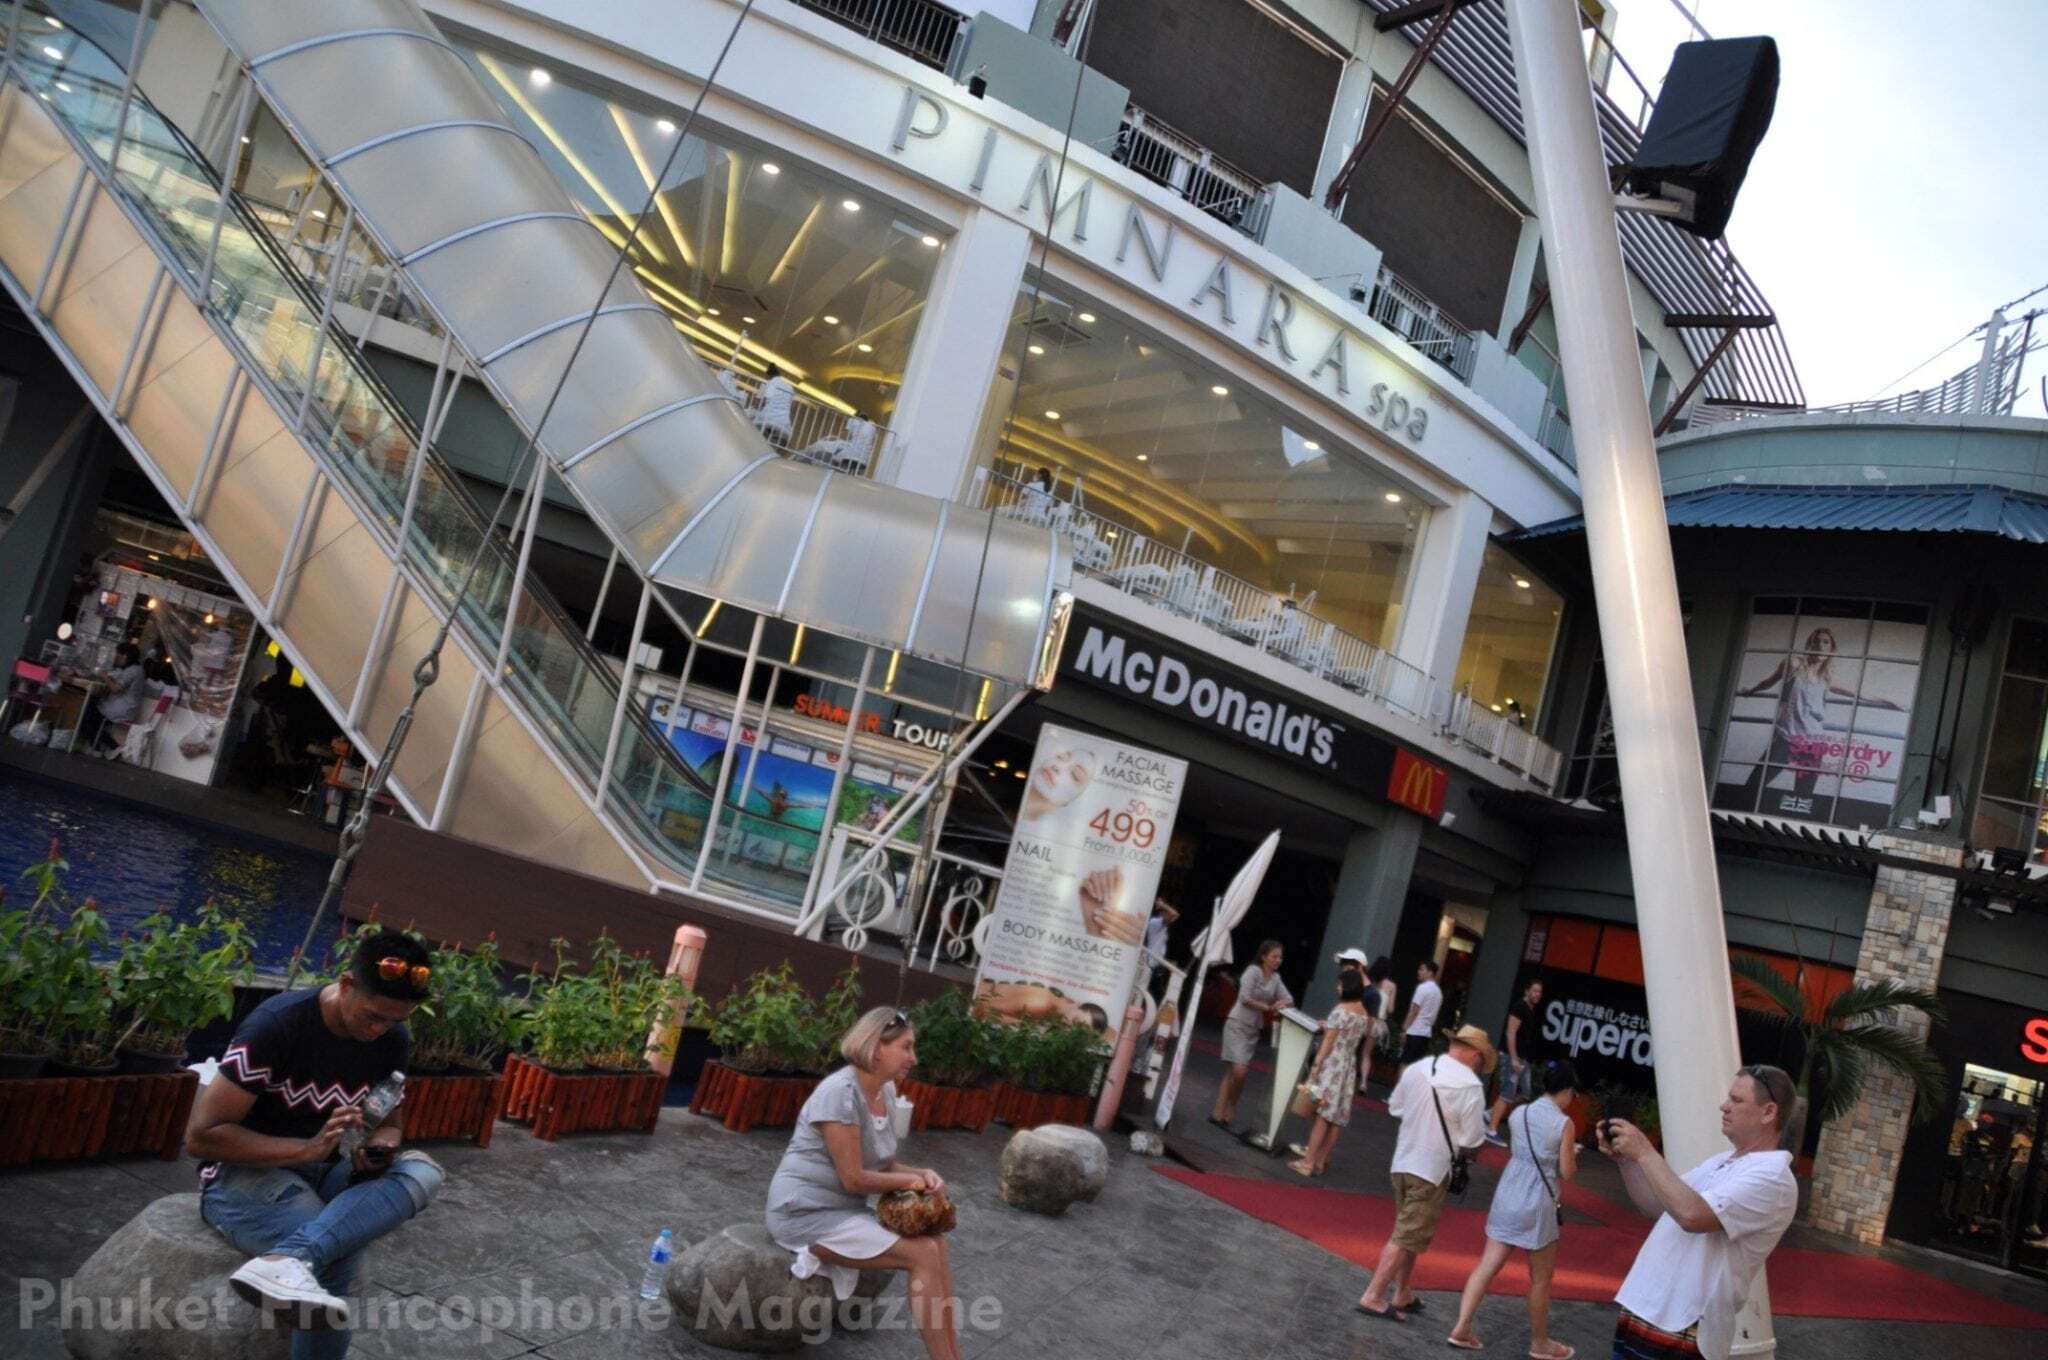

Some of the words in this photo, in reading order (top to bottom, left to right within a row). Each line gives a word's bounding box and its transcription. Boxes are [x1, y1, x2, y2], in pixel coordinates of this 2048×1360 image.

[890, 84, 1352, 396] PIMNARA
[1364, 380, 1430, 442] spa
[1074, 626, 1337, 768] McDonald's
[892, 719, 972, 752] TOUR
[1788, 734, 1892, 768] Superdry
[1101, 764, 1175, 794] MASSAGE
[1115, 751, 1167, 777] FACIAL
[1015, 840, 1053, 863] NAIL
[1084, 836, 1117, 853] From
[1002, 919, 1047, 942] BODY
[1049, 932, 1124, 963] MASSAGE
